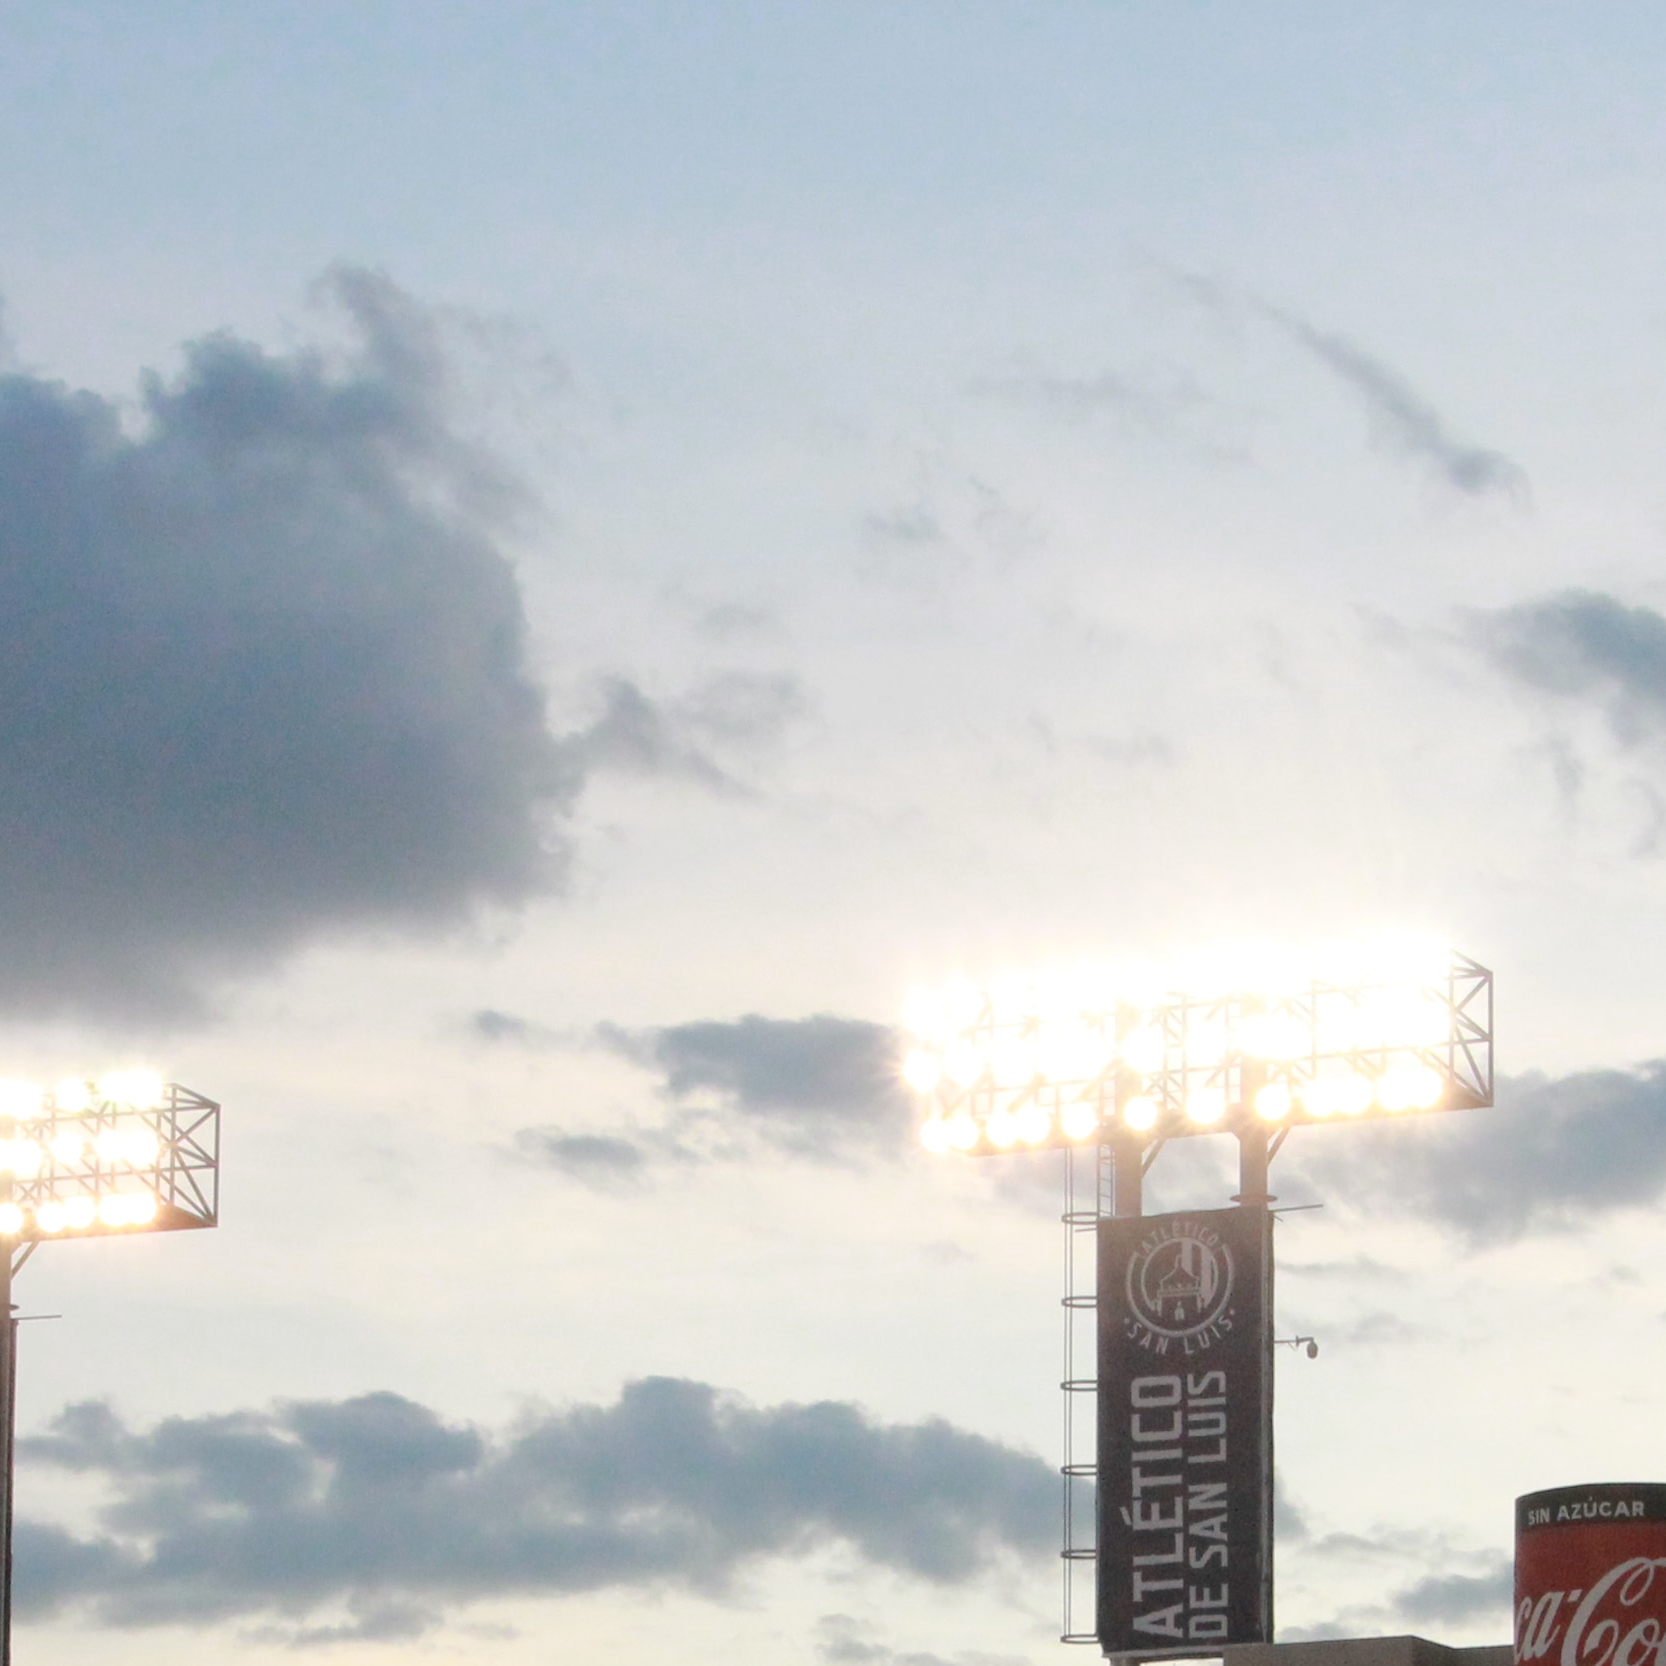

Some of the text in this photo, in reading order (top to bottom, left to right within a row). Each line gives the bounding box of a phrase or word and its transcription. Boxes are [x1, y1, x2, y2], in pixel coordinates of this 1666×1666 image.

[1118, 1374, 1184, 1640] ATLÉTICO
[1186, 1369, 1229, 1640] DE SAN LUIS
[1527, 1497, 1646, 1526] SIN AZÚCAR
